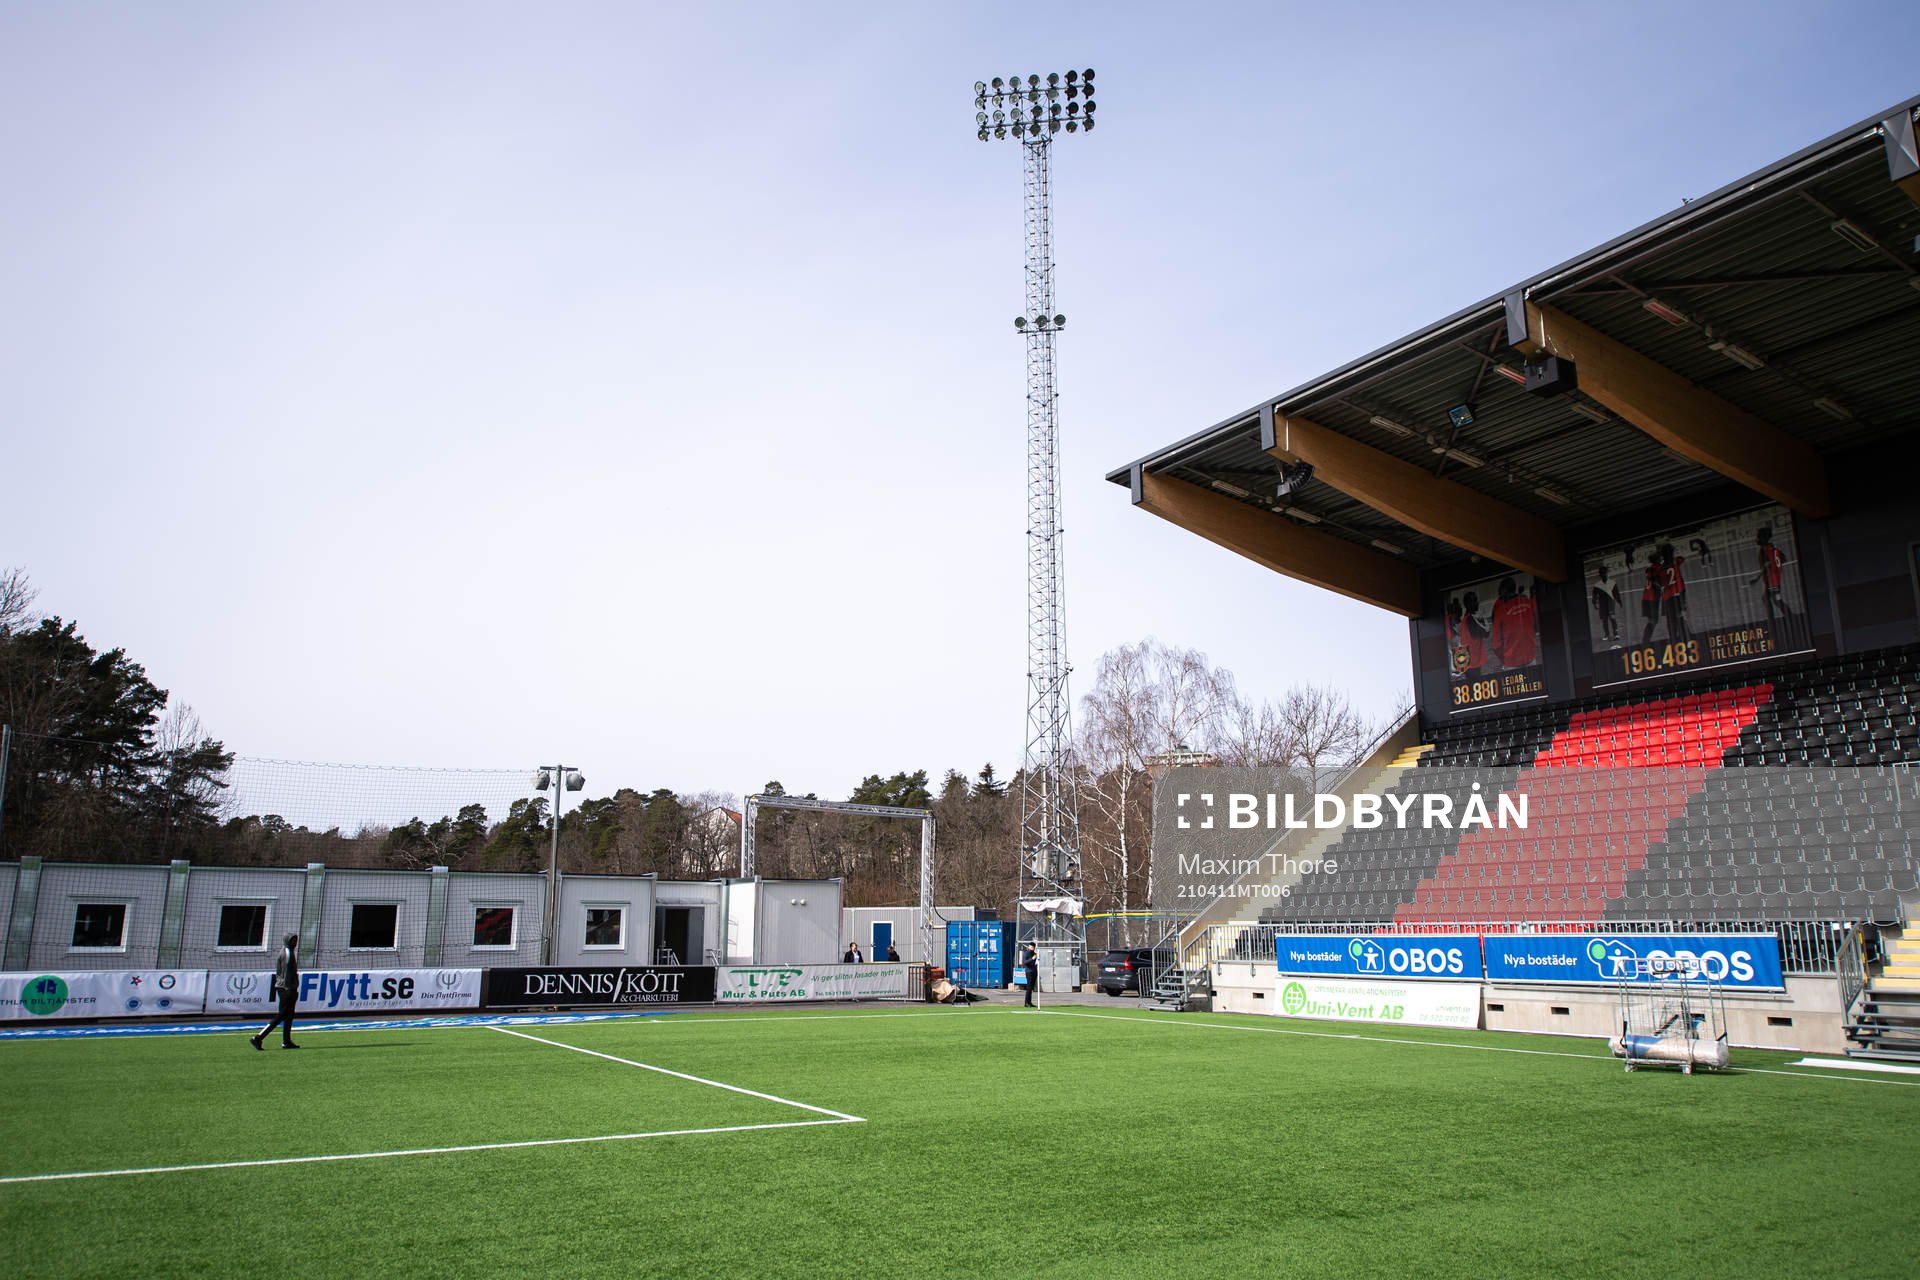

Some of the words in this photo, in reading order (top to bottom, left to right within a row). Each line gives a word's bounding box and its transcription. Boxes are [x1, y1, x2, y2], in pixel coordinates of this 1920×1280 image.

[1709, 627, 1768, 648] DELTAGAR-
[1621, 640, 1700, 675] 196.483
[1711, 639, 1775, 660] TILLFÄLLEN
[1453, 679, 1499, 705] 38.880
[1503, 681, 1543, 695] TILLFÄLLEN
[1290, 951, 1306, 962] Nya
[1307, 952, 1342, 962] bostäder
[1389, 948, 1464, 973] OBOS
[1504, 954, 1526, 967] Nya
[1528, 955, 1577, 967] bostäder
[523, 973, 614, 995] DENNIS
[625, 969, 684, 993] KÖTT
[620, 994, 628, 1002] &
[722, 990, 746, 998] Mur
[749, 990, 757, 998] &
[760, 990, 786, 998] Puts
[789, 989, 805, 997] AB
[1306, 1000, 1374, 1018] Uni-Vent
[1379, 1004, 1404, 1020] AB
